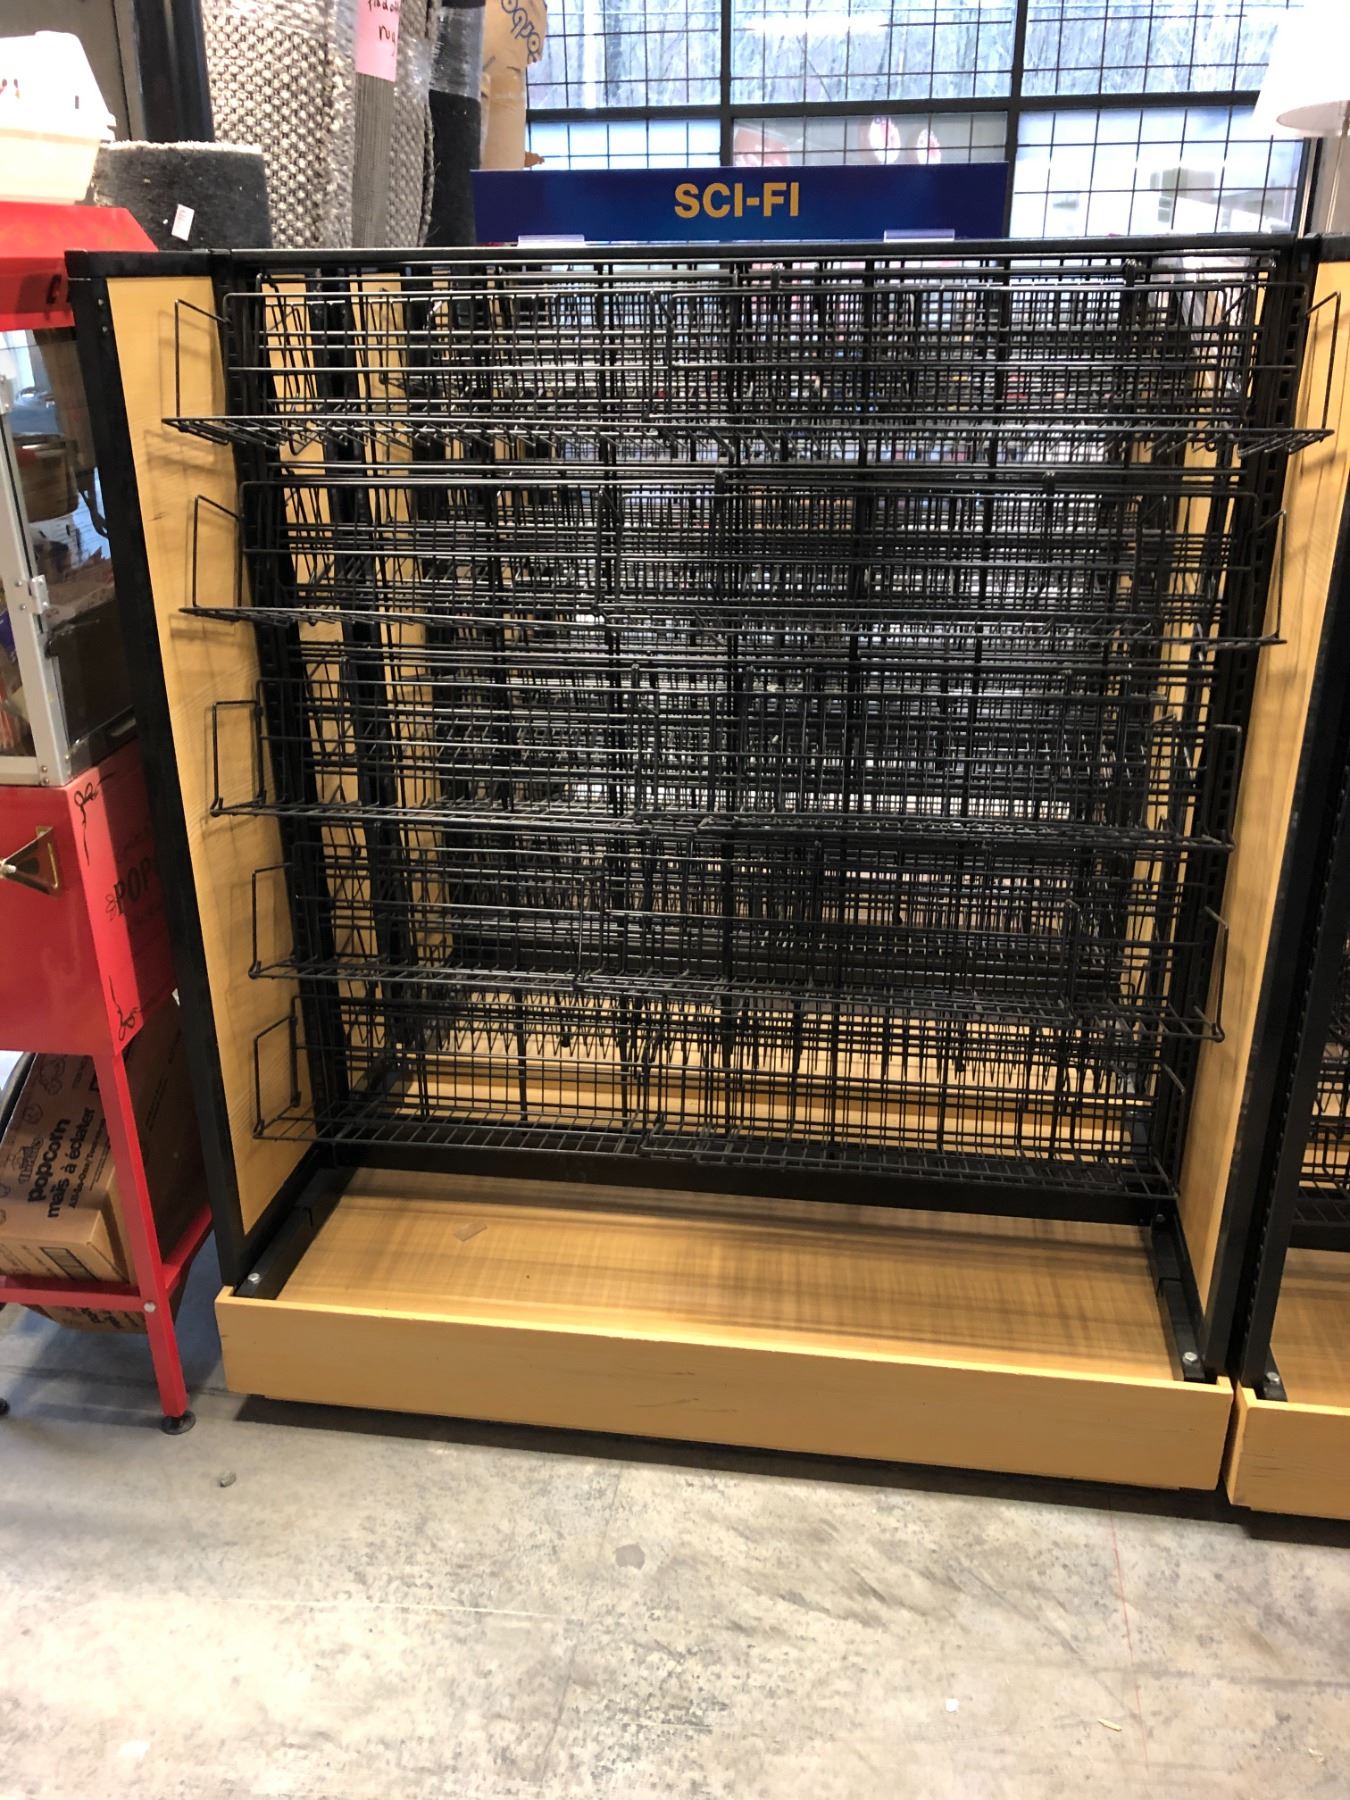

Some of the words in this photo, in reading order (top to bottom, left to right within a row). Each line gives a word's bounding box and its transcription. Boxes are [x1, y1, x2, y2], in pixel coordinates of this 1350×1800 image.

[674, 182, 799, 219] SCI-FI
[64, 1106, 95, 1160] éclater
[27, 1118, 71, 1203] popcorn
